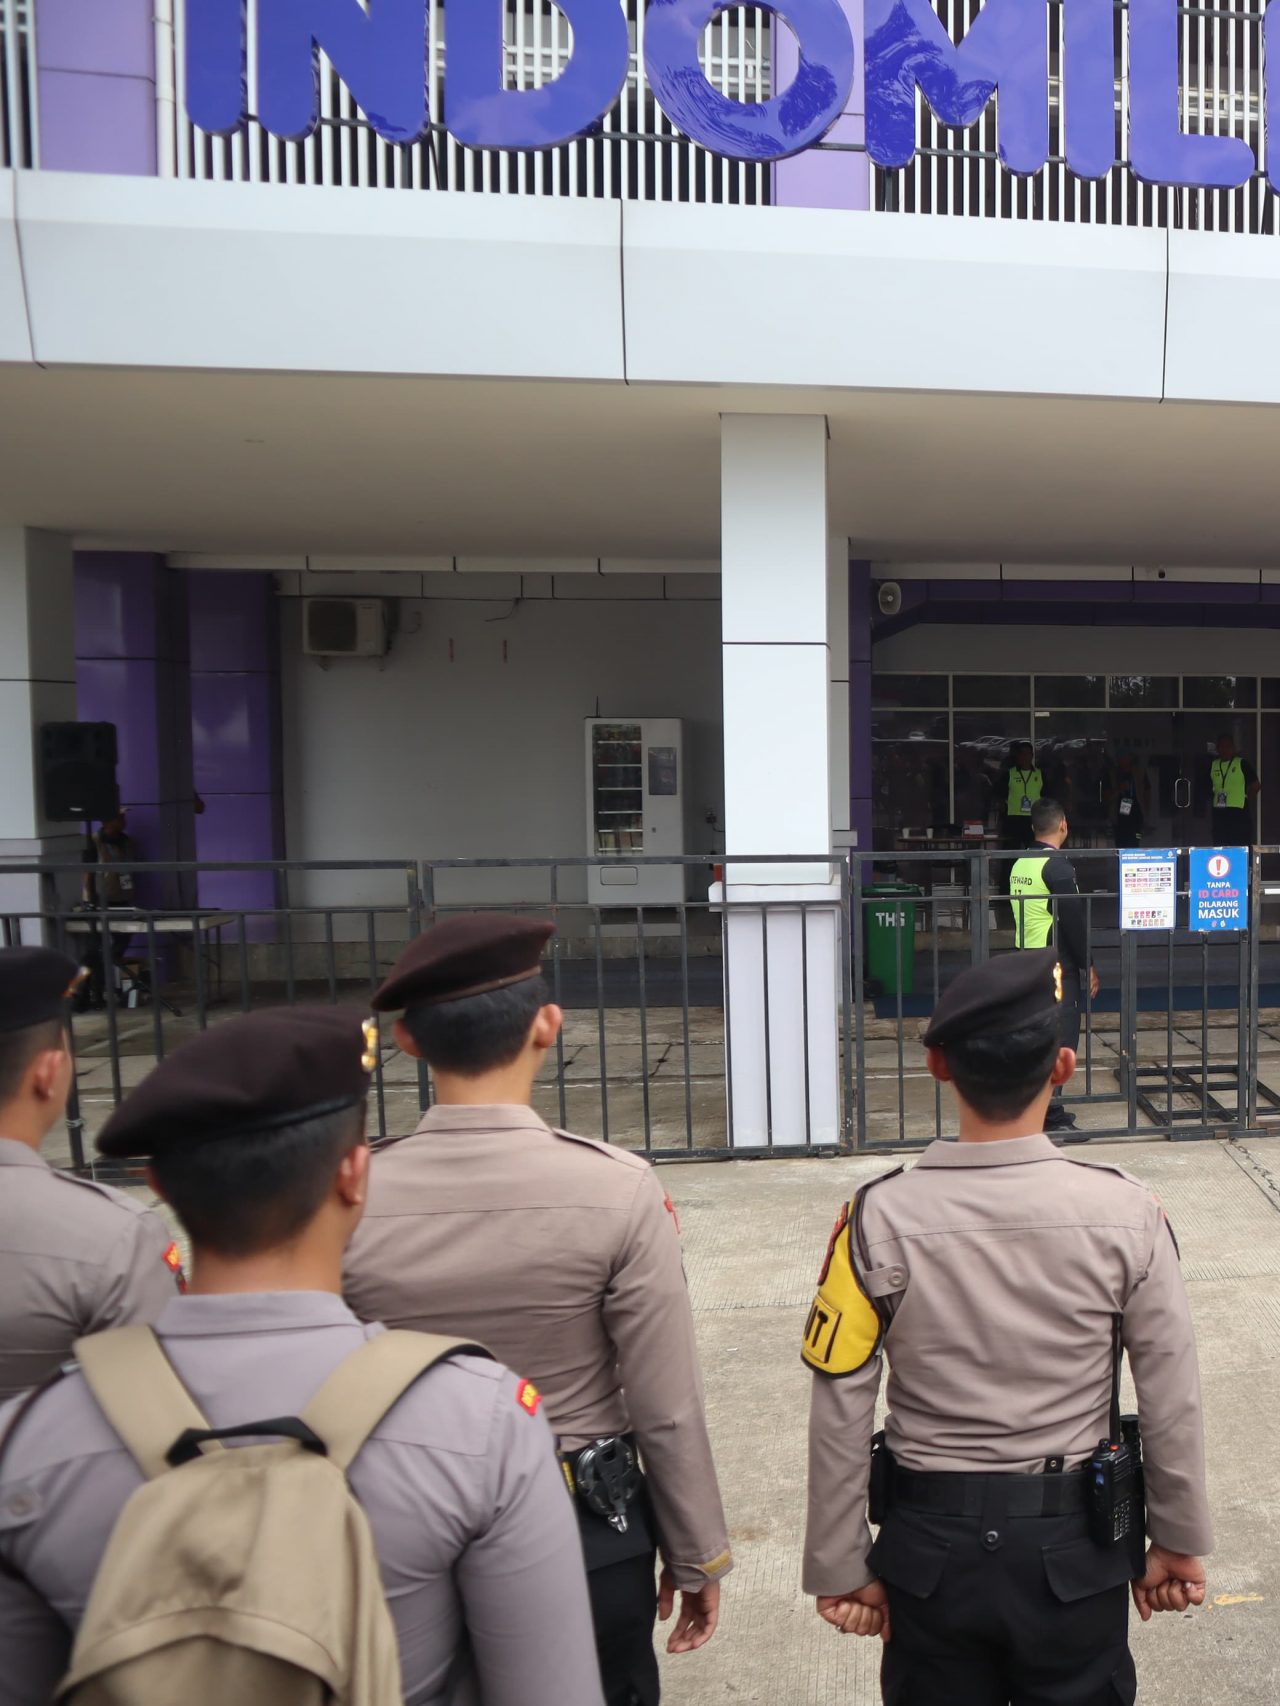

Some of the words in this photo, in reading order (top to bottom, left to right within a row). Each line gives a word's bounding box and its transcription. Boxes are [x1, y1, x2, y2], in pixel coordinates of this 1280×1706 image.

[1207, 881, 1231, 889] TANPA
[1198, 889, 1209, 899] ID
[1211, 889, 1240, 898] CARD
[1198, 900, 1239, 908] DILARANG
[1198, 908, 1240, 919] MASUK
